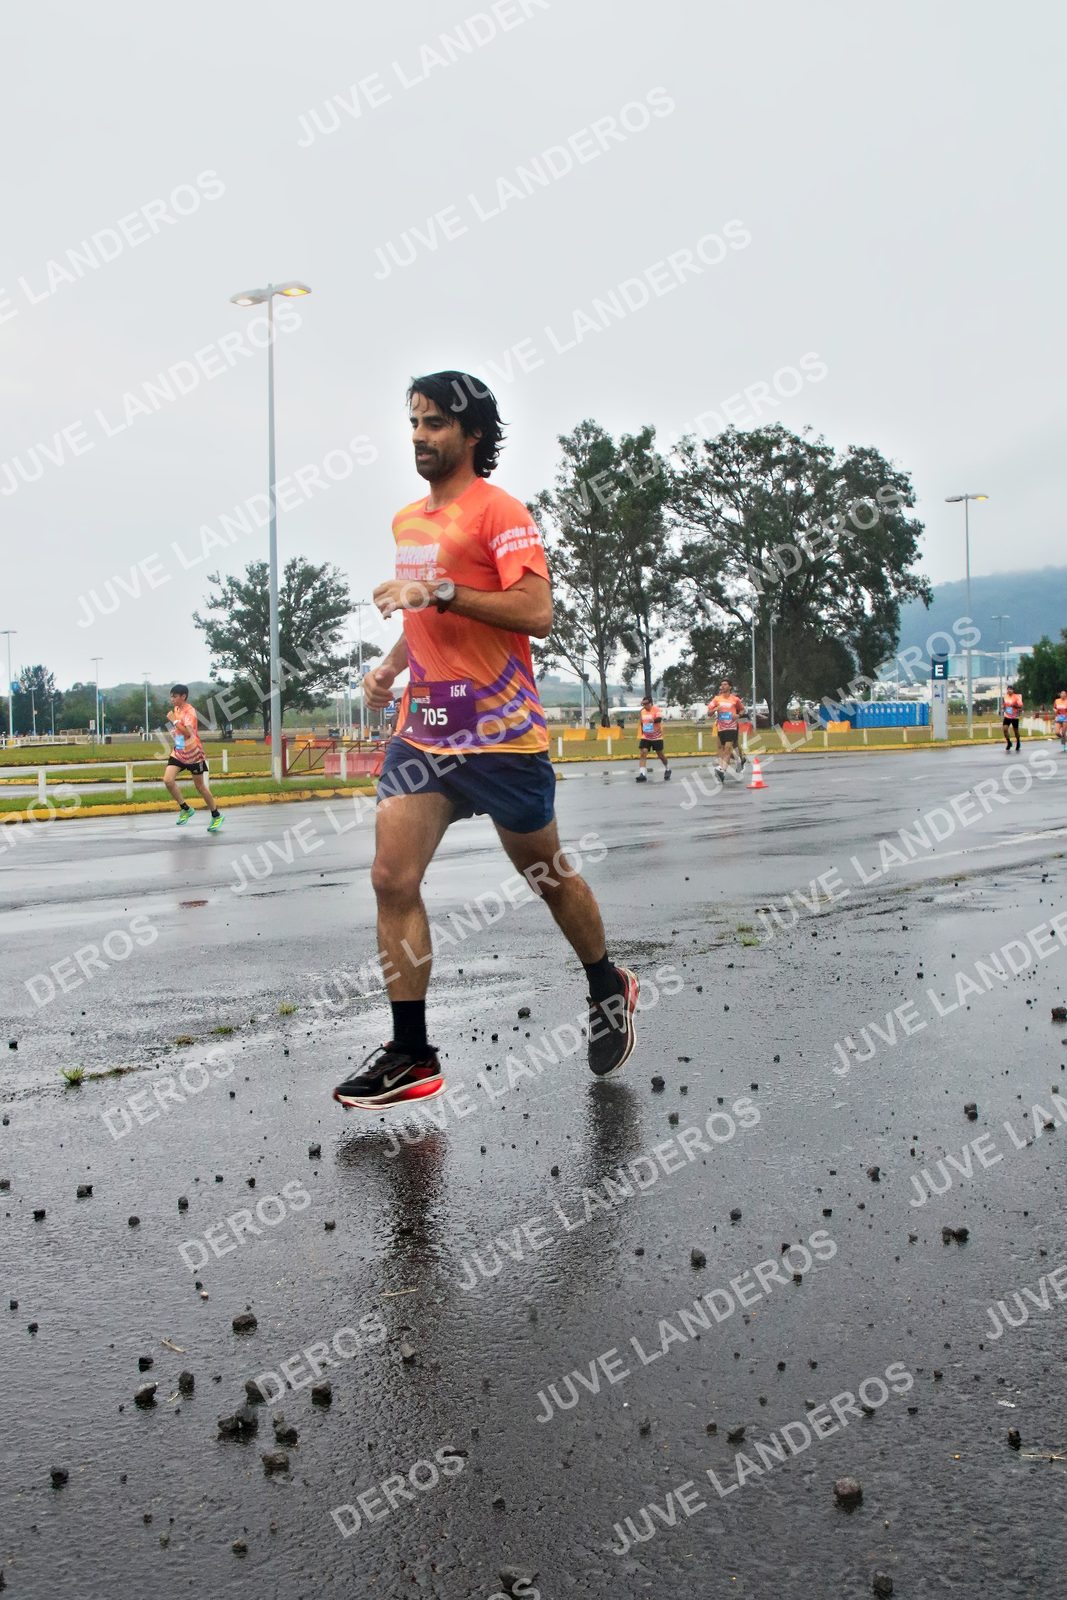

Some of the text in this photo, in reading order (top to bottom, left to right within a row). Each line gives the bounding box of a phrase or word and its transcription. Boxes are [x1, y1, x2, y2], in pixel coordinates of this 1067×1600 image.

[934, 664, 944, 677] E
[450, 684, 467, 697] 15K
[421, 707, 449, 726] 705
